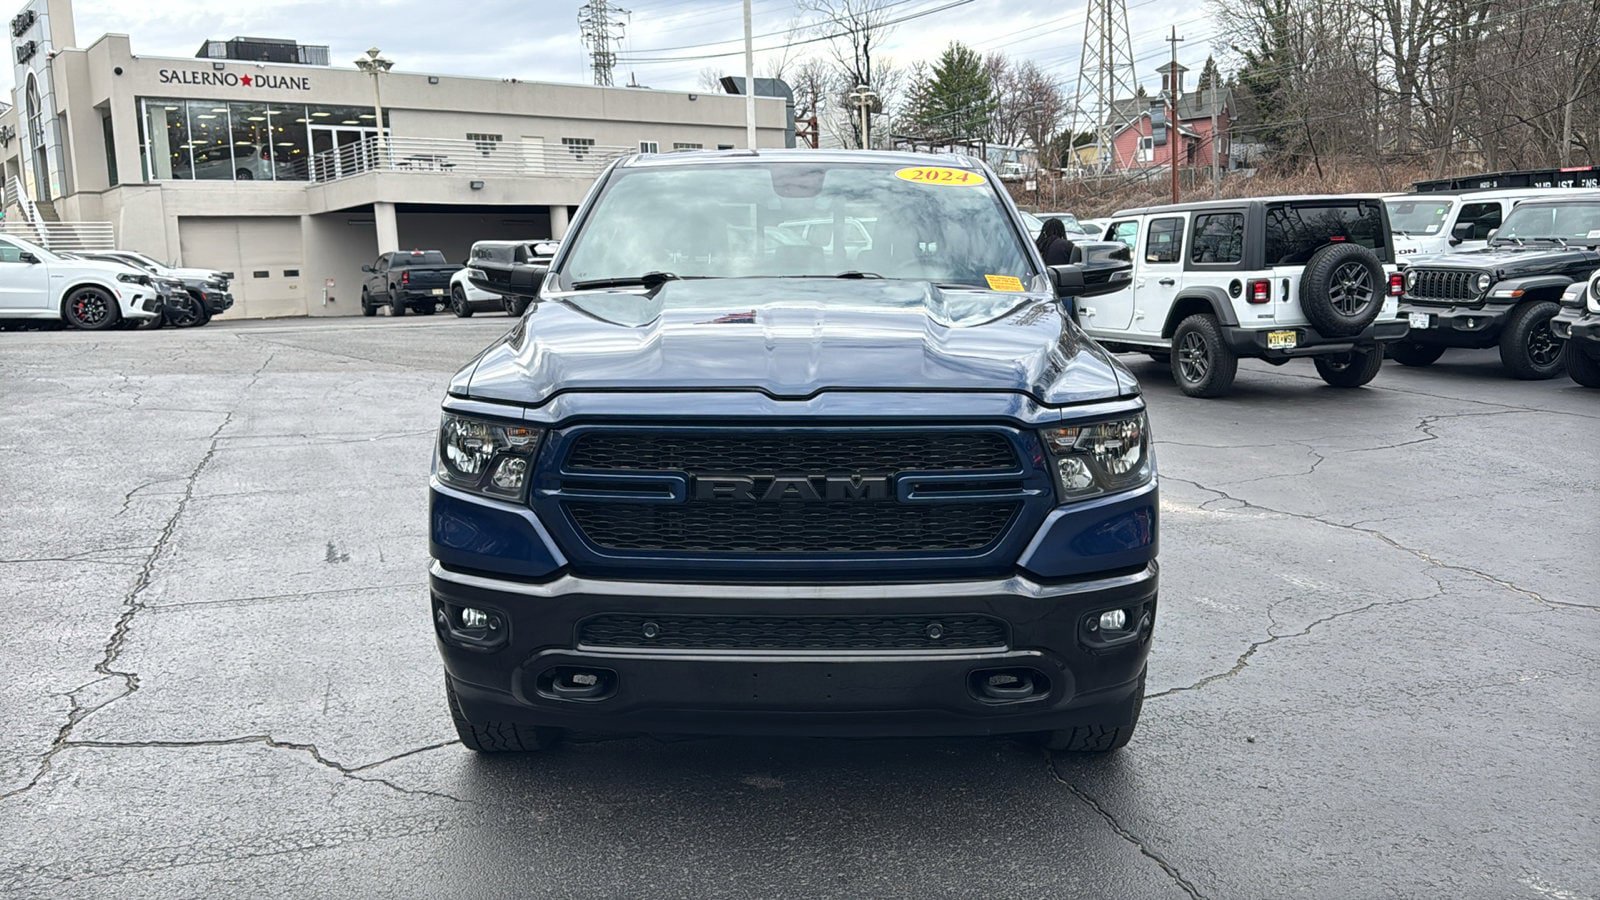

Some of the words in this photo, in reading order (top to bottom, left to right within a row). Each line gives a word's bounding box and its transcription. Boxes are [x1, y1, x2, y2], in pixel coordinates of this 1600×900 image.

[159, 69, 239, 87] SALERNO
[254, 74, 311, 91] DUANE
[911, 169, 969, 183] 2024
[696, 475, 888, 501] RAM
